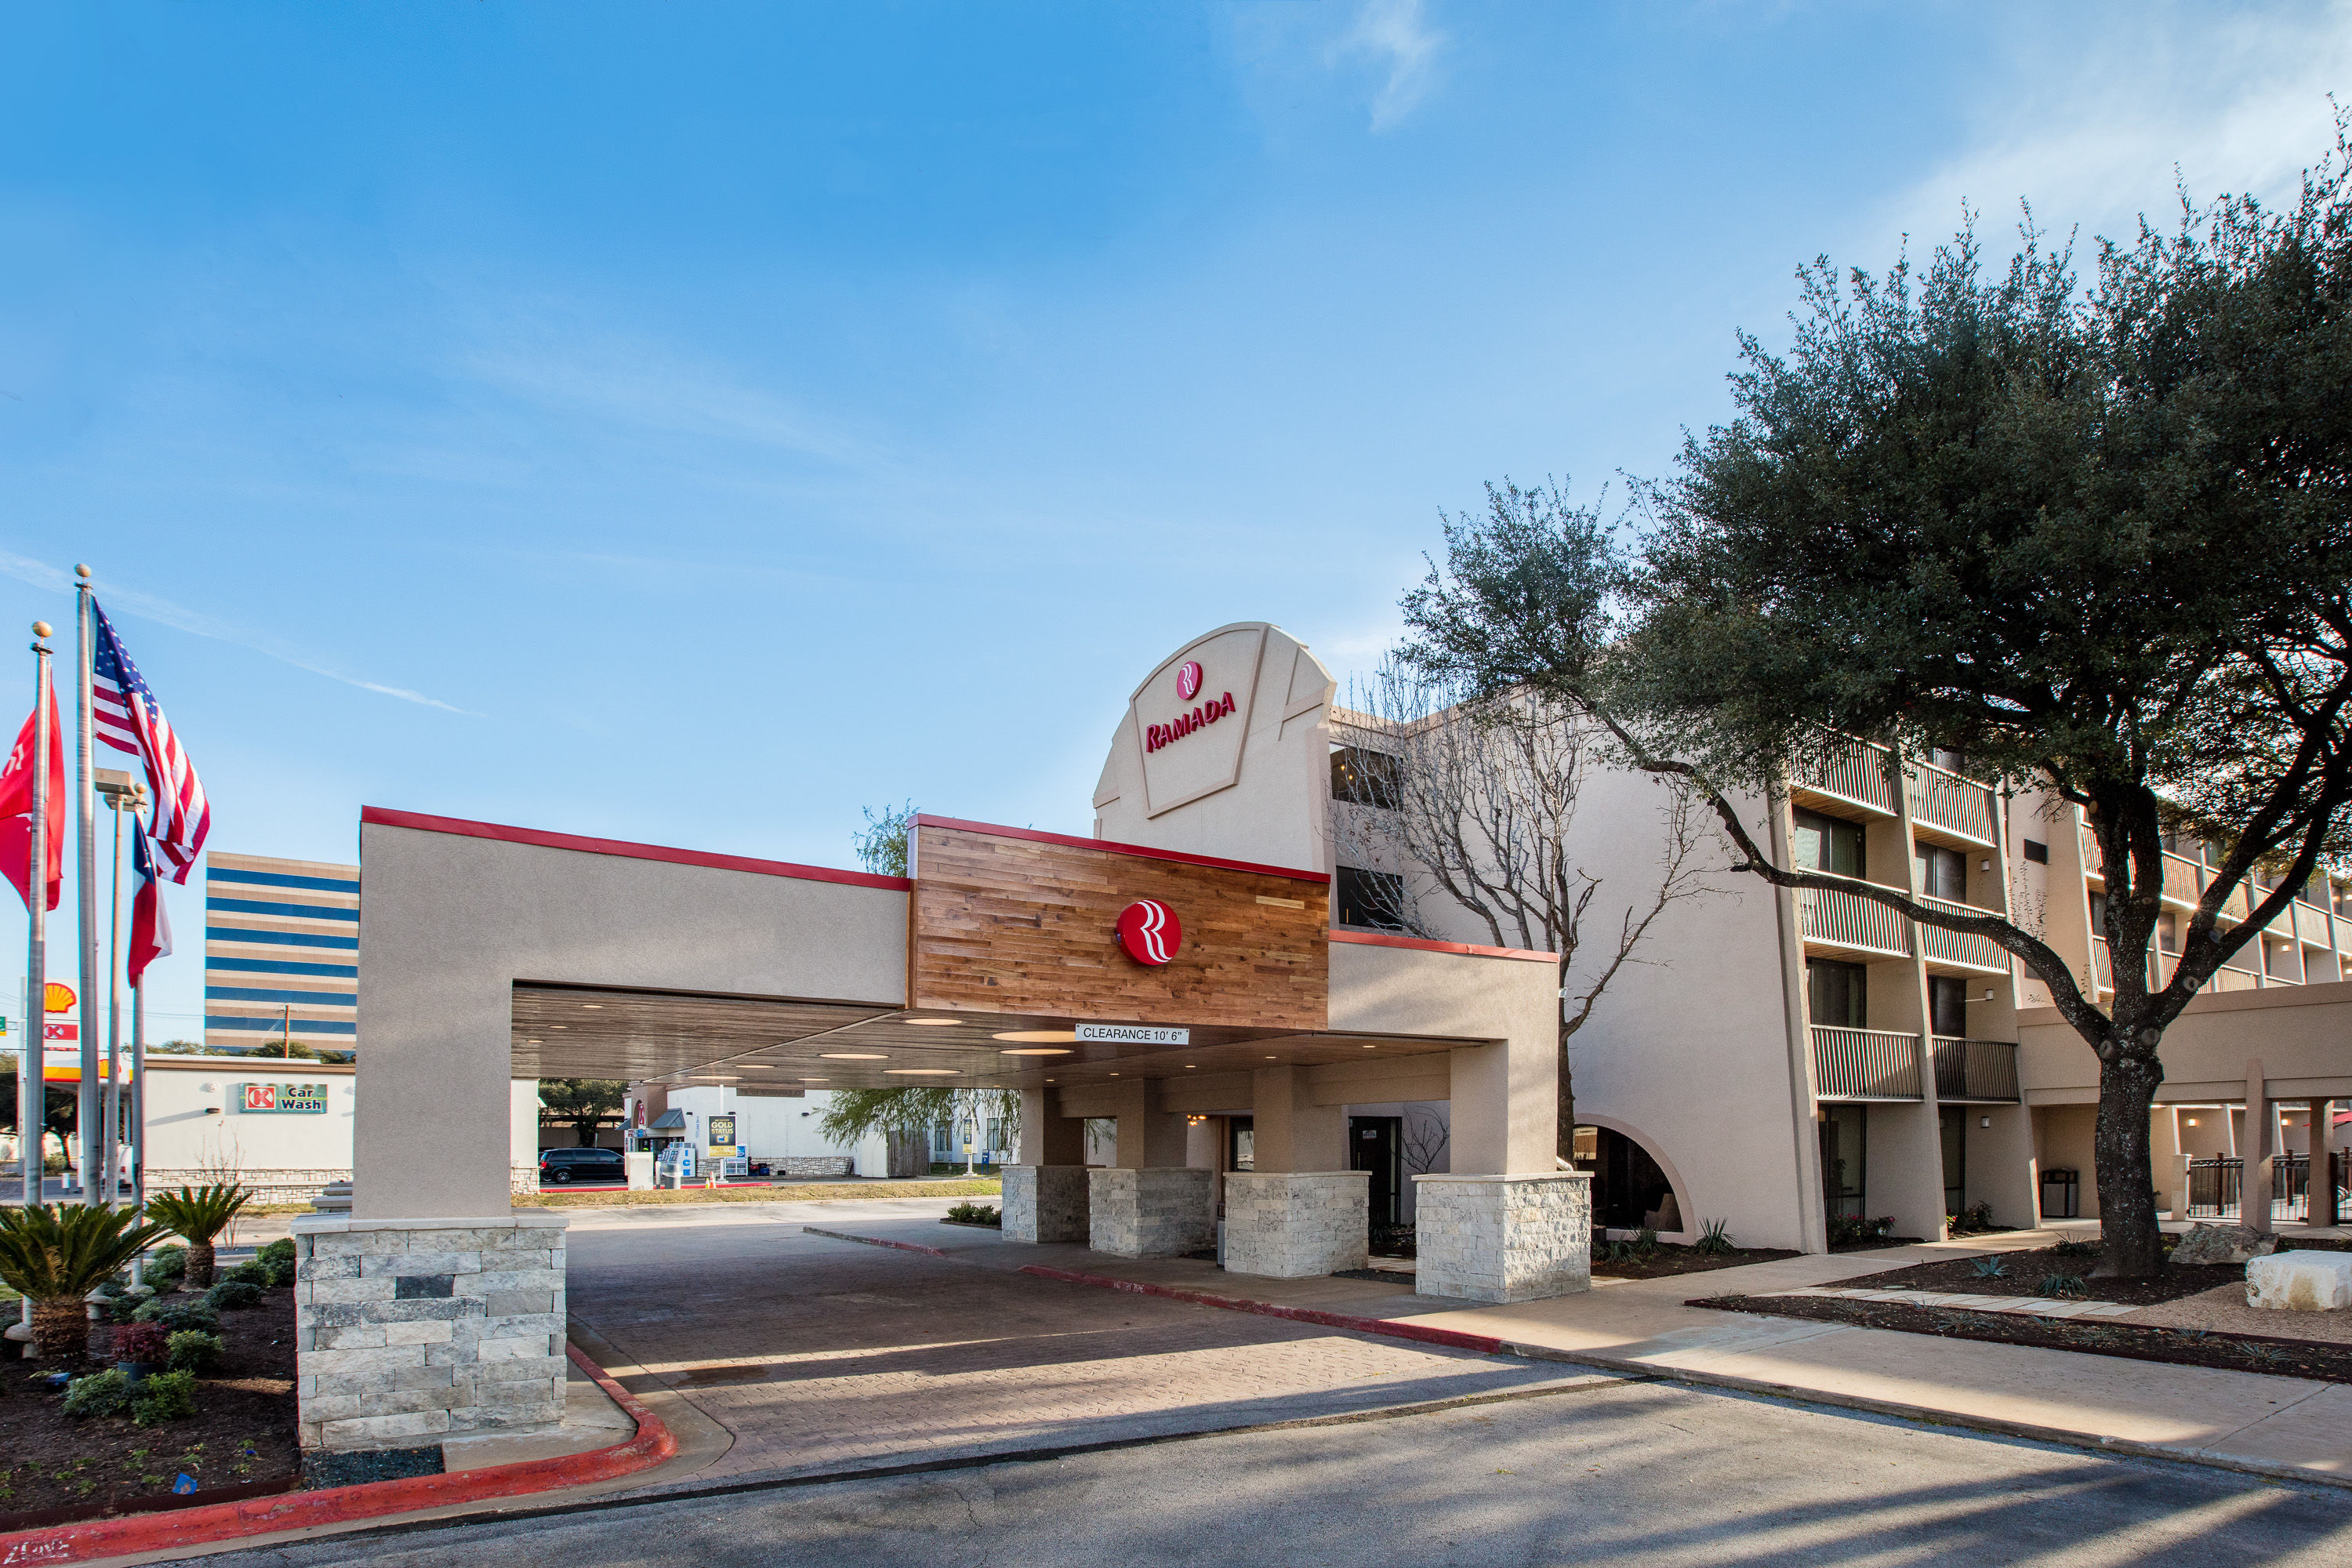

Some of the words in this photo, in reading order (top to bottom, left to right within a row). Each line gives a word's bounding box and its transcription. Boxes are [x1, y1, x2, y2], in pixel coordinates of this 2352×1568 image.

[1146, 691, 1236, 753] RAMADA
[1083, 1027, 1151, 1040] CLEARANCE
[253, 1090, 273, 1106] K
[288, 1087, 314, 1098] Car
[281, 1099, 321, 1109] Wash
[682, 1149, 691, 1176] ICE
